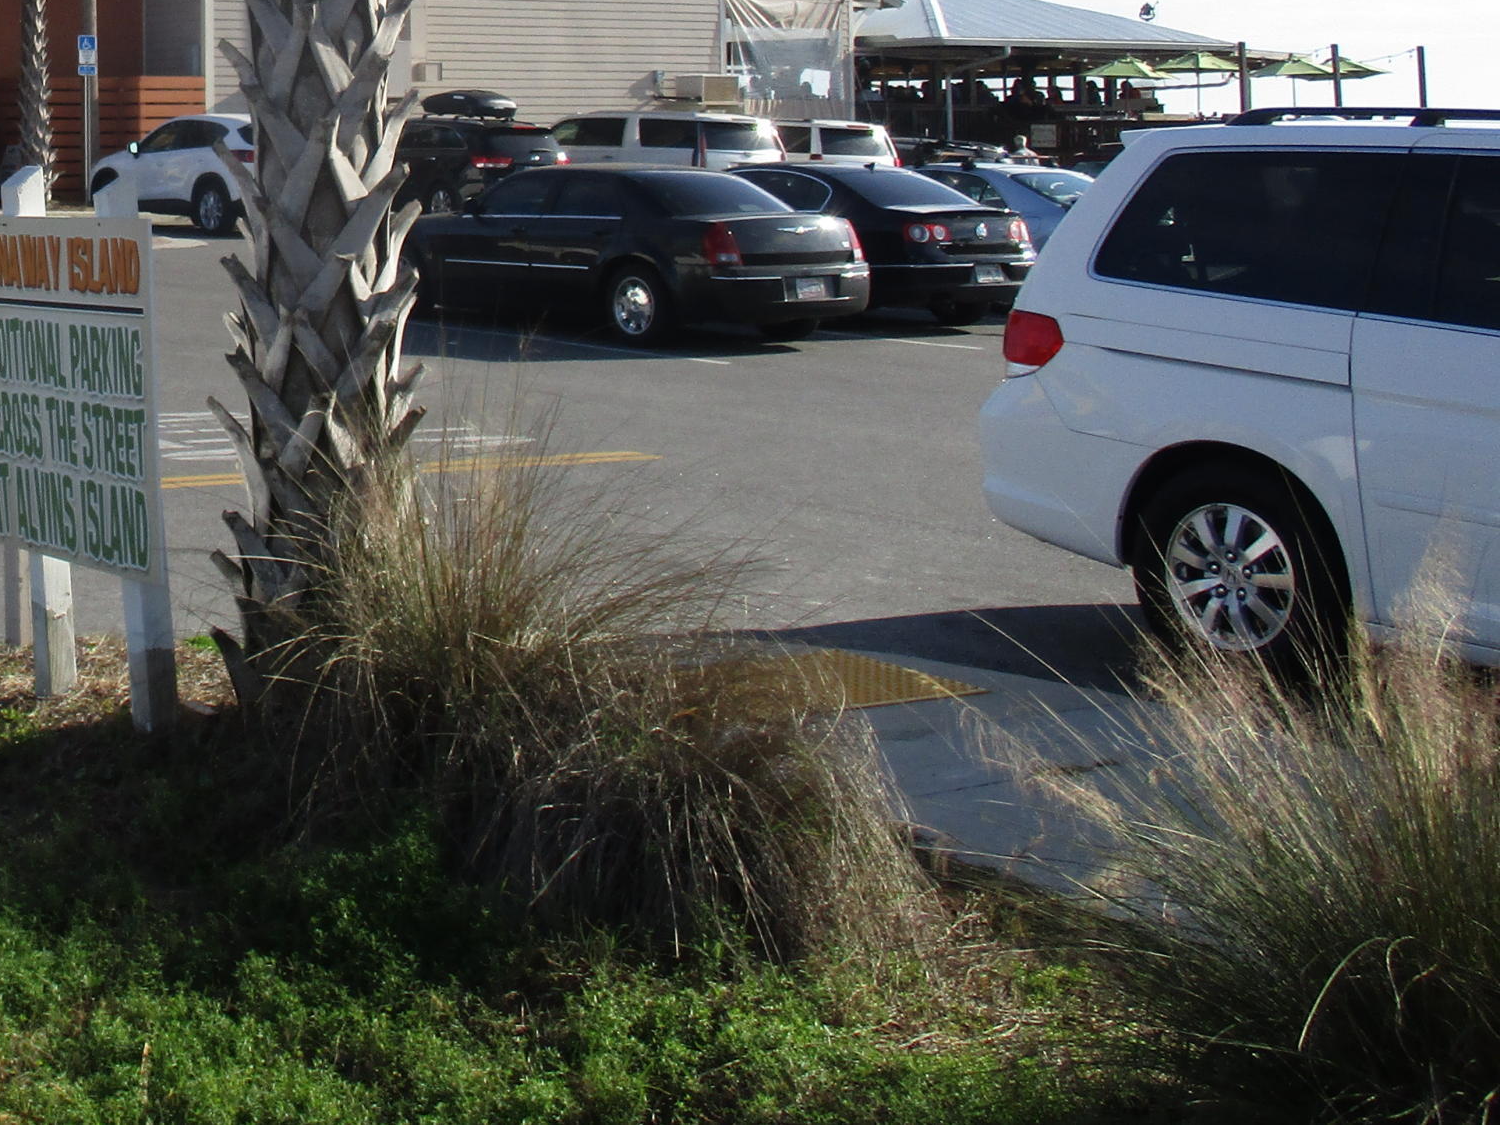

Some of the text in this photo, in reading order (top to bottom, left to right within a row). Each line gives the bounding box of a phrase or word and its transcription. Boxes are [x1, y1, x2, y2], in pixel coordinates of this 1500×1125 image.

[66, 236, 141, 296] ISLAND
[69, 324, 143, 396] PARKING
[45, 396, 78, 468] THE
[81, 401, 145, 478] STREET
[16, 466, 77, 553] ALVINS
[80, 479, 149, 569] ISLAND
